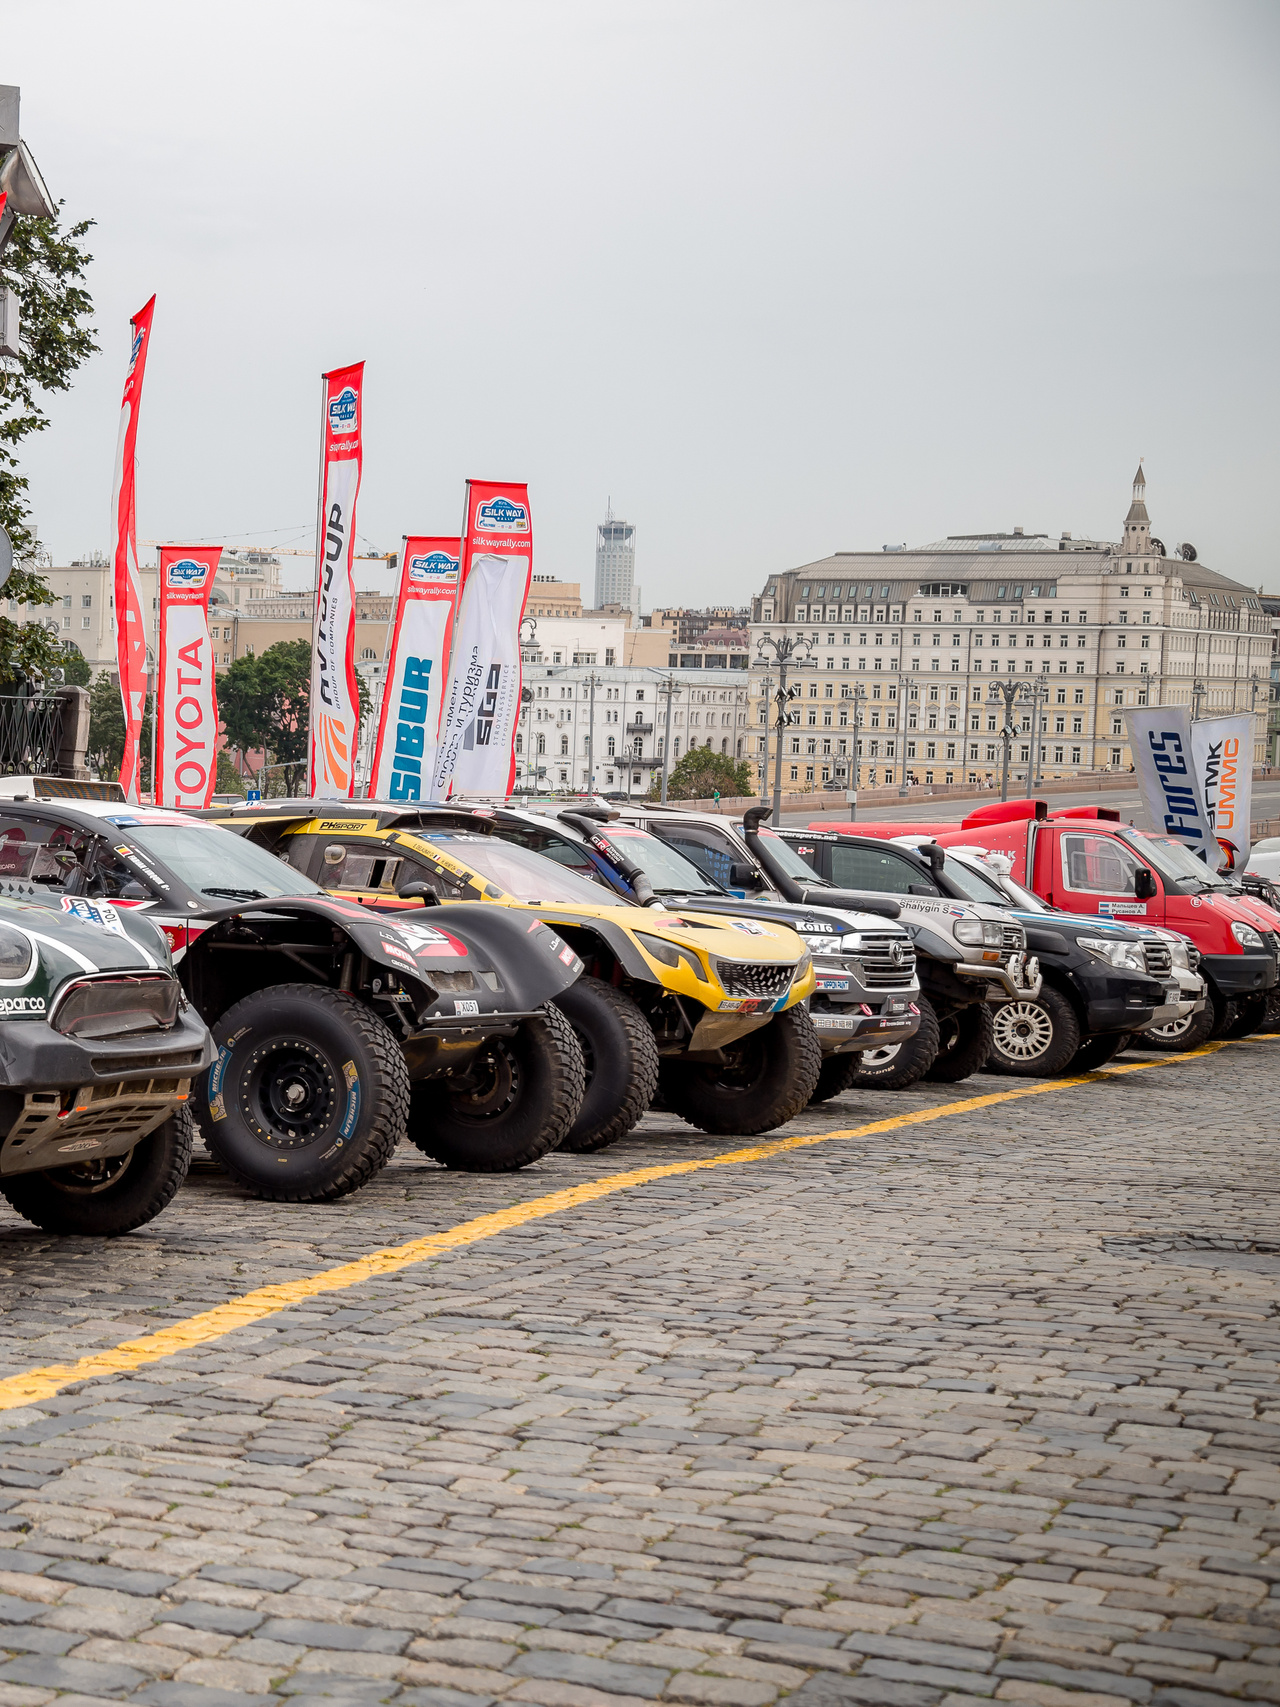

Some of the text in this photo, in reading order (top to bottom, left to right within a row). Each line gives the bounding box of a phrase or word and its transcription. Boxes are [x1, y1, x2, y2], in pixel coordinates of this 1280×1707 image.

[483, 508, 523, 518] SILK WAY
[472, 537, 531, 549] silkwayrally.com
[413, 561, 458, 571] SILK WAY
[328, 597, 339, 656] COMPANIES
[334, 676, 342, 710] GROUP
[459, 645, 479, 716] туризма
[493, 664, 510, 746] STROYGASSERVICE
[389, 656, 433, 801] SIBUR
[1217, 737, 1240, 830] UMMC
[591, 836, 608, 852] GR
[103, 908, 118, 924] 104
[899, 901, 940, 913] Shalygin
[461, 1001, 478, 1013] X051
[211, 1049, 228, 1093] MICHELIN
[343, 1091, 357, 1136] MICHELIN
